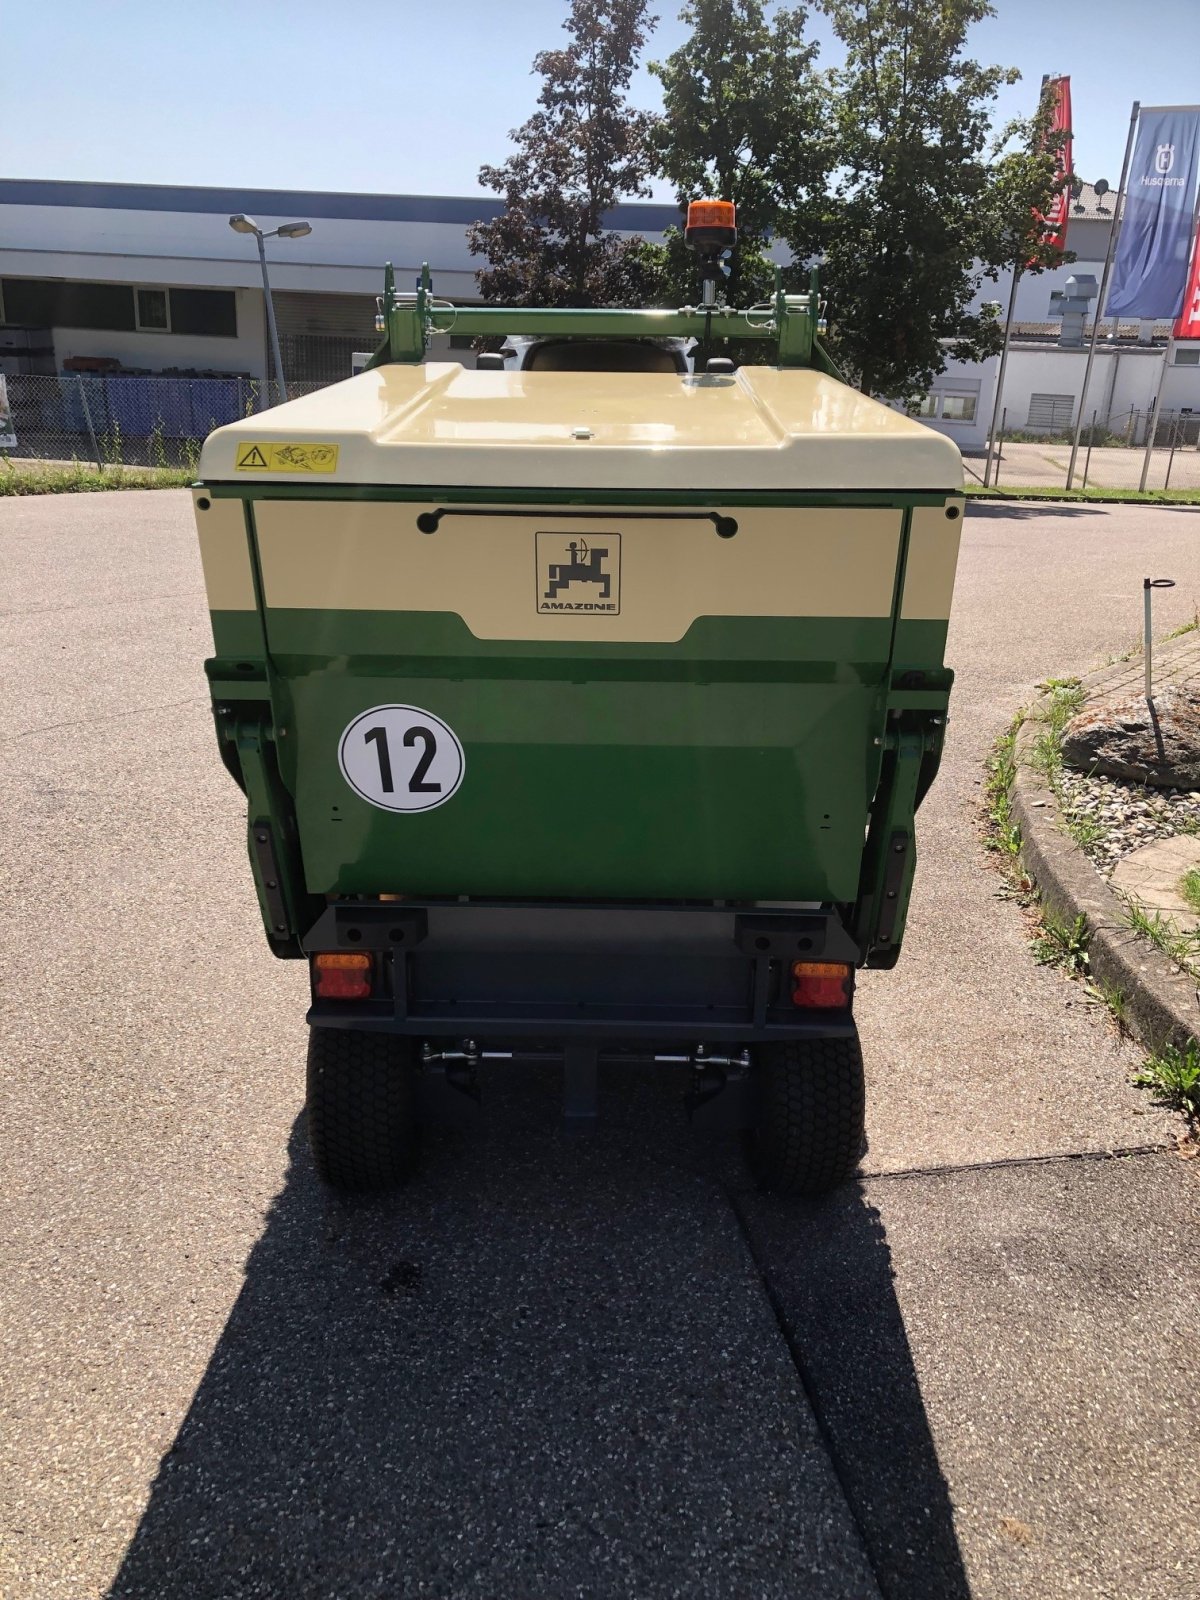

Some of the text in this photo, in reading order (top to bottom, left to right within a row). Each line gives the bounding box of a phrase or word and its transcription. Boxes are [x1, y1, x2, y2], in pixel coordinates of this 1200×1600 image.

[1141, 176, 1185, 187] Husqarna
[540, 602, 616, 611] AMAZONE
[364, 726, 442, 793] 12
